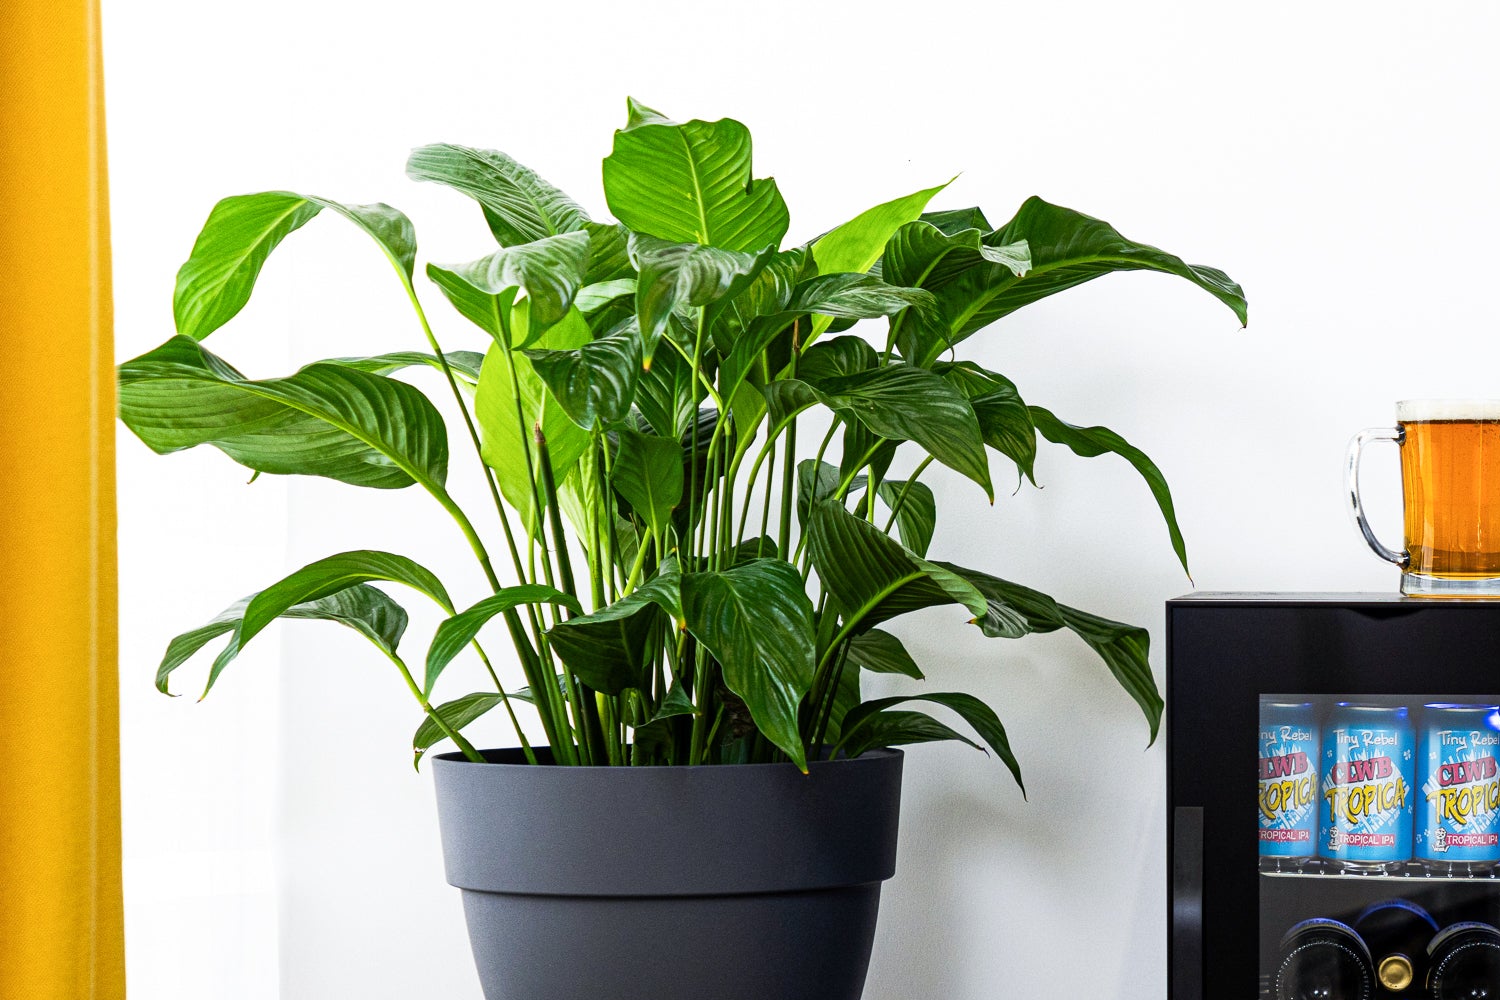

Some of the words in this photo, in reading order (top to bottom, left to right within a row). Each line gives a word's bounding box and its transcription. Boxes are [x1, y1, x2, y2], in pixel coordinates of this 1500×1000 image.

[1260, 731, 1277, 747] ny
[1280, 725, 1312, 741] Rebel
[1333, 729, 1360, 750] Tiny
[1361, 730, 1398, 746] Rebel
[1437, 731, 1468, 752] Tiny
[1469, 731, 1500, 746] Rebel
[1259, 752, 1308, 780] LWB
[1332, 756, 1393, 784] CLWB
[1437, 756, 1497, 785] CLWB
[1259, 773, 1318, 820] ROPICA
[1324, 777, 1405, 824] TROPICA
[1259, 830, 1296, 840] ROPICAL
[1299, 830, 1310, 840] IPA
[1339, 835, 1380, 844] TROPICAL
[1381, 835, 1395, 844] IPA
[1446, 835, 1487, 845] TROPICAL
